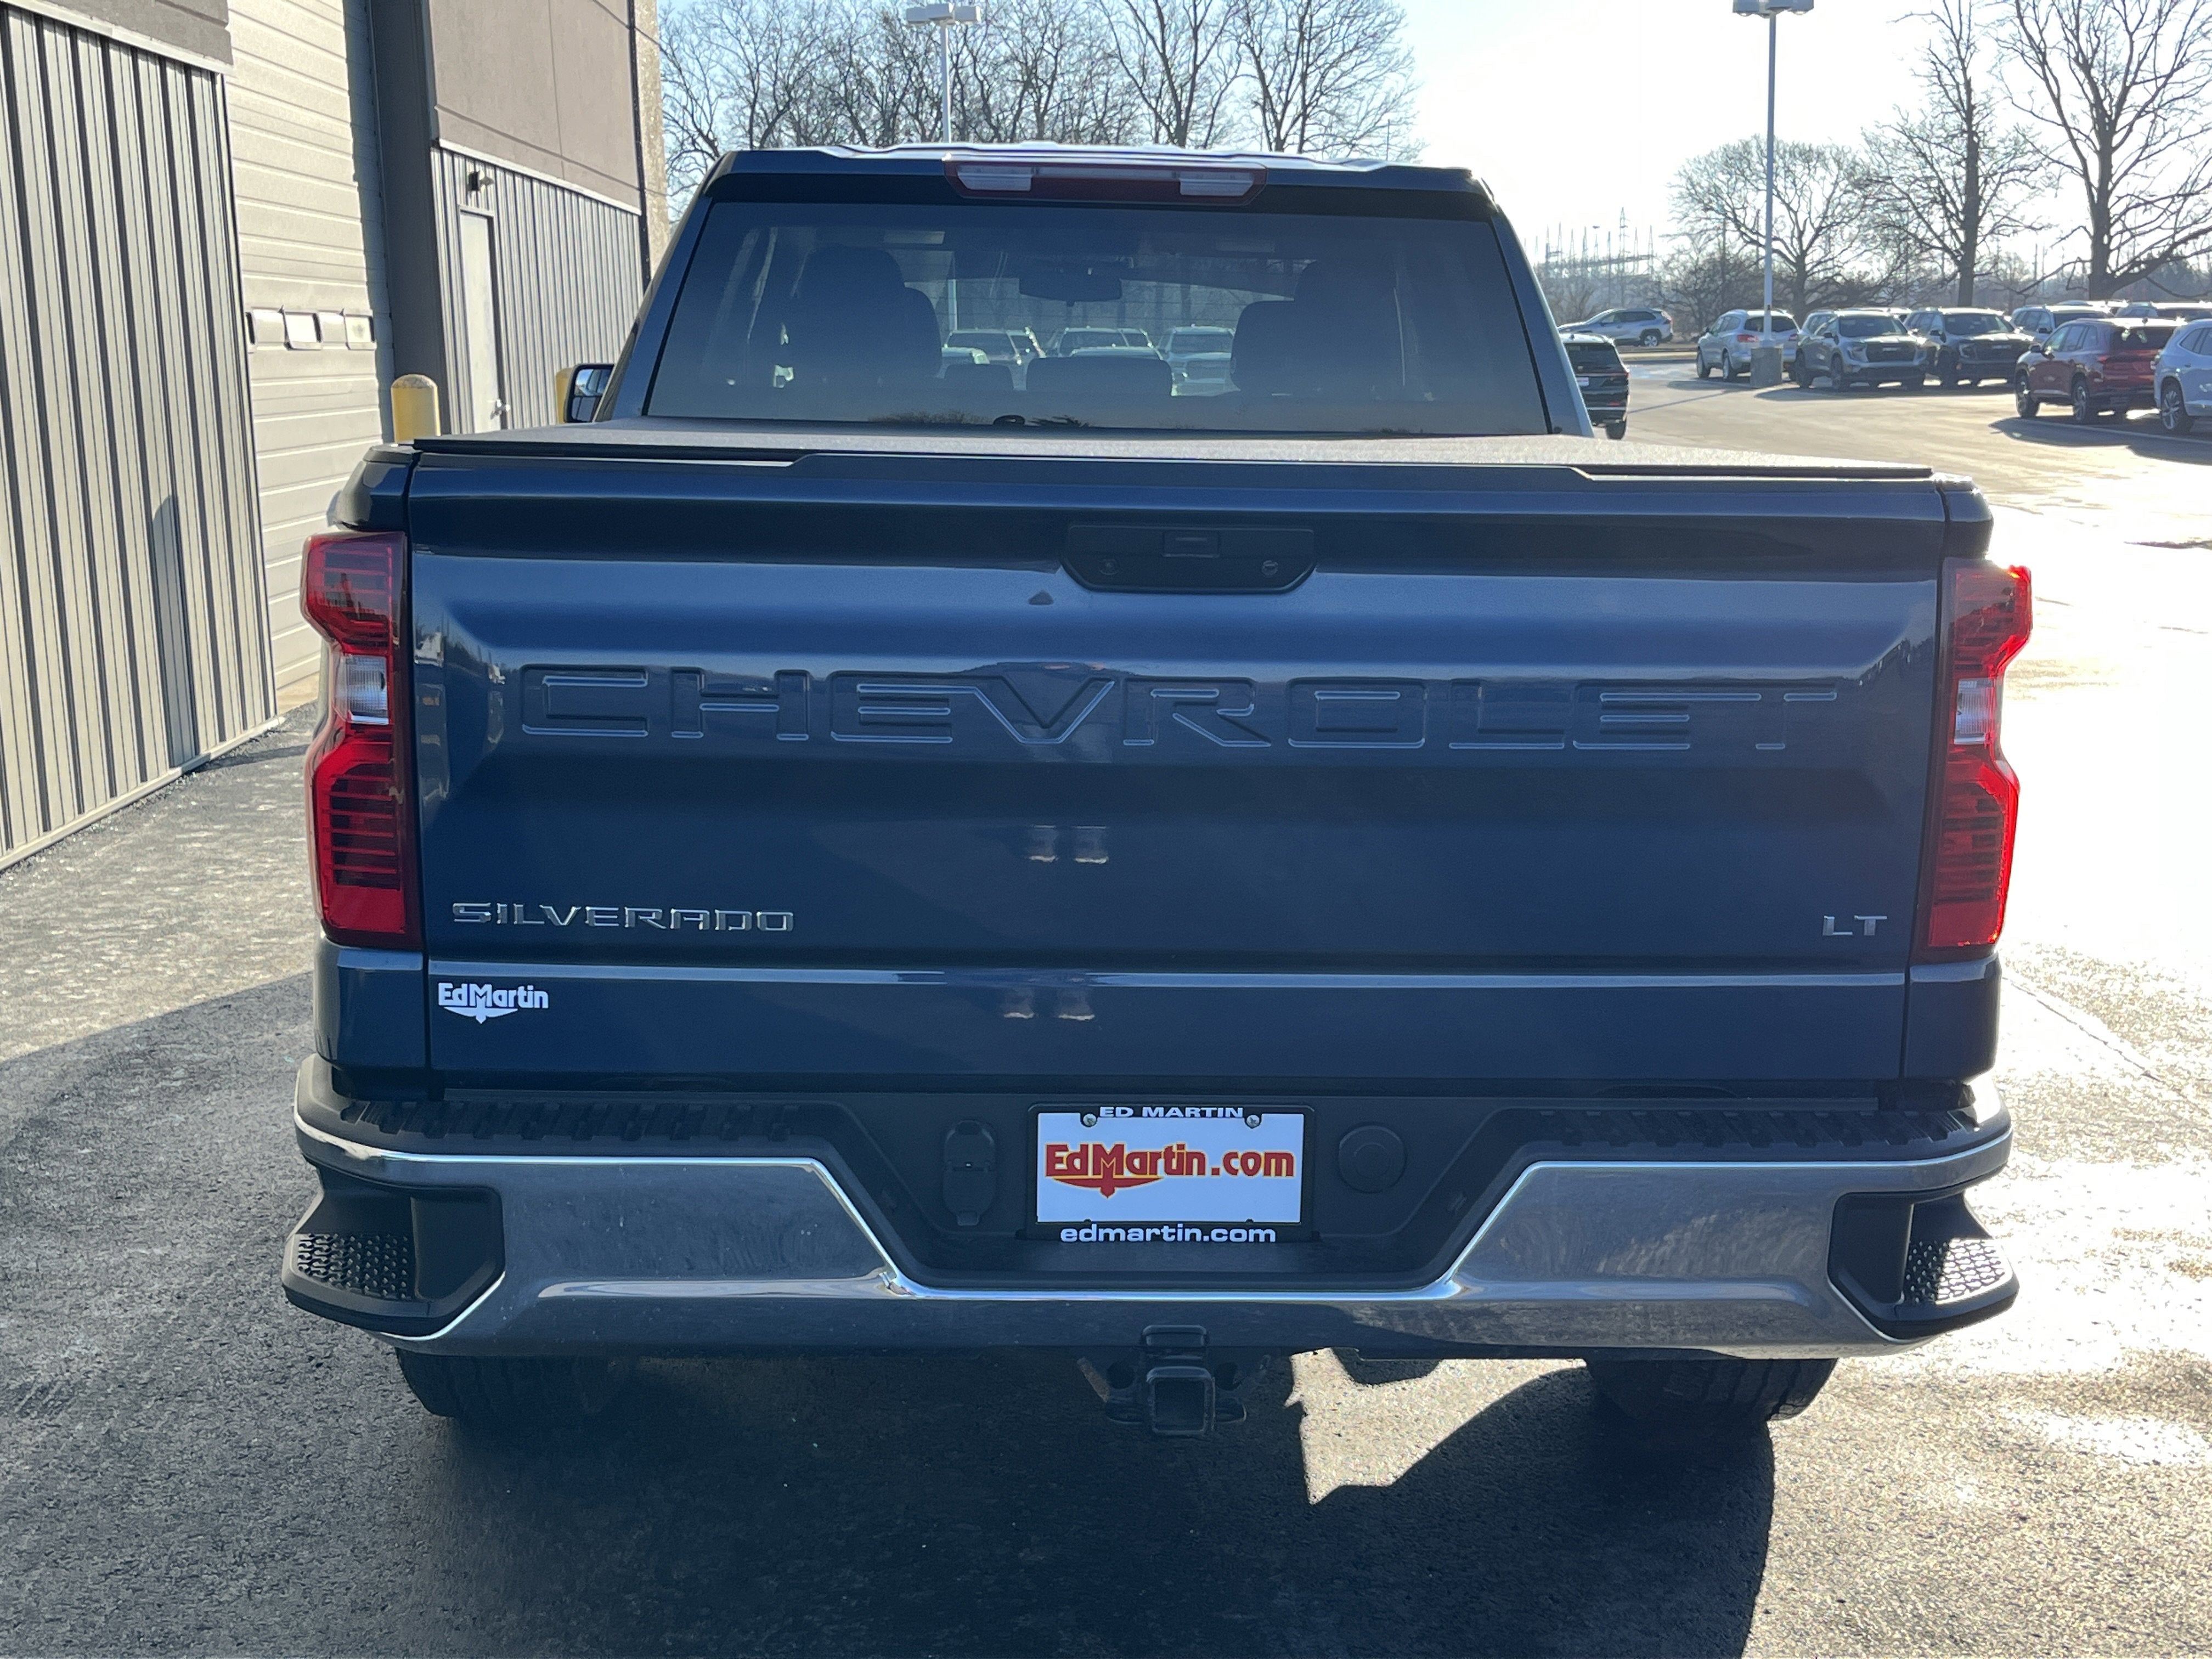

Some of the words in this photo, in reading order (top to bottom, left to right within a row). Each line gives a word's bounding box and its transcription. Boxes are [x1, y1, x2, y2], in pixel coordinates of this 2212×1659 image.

[521, 664, 1839, 752] CHEVROLET
[453, 902, 794, 932] SILVERADO
[1822, 915, 1888, 936] LT
[1099, 1107, 1134, 1118] ED
[1142, 1107, 1244, 1118] MARTIN
[1045, 1143, 1295, 1178] EdMartin.com
[1060, 1224, 1277, 1243] edmartin.com
